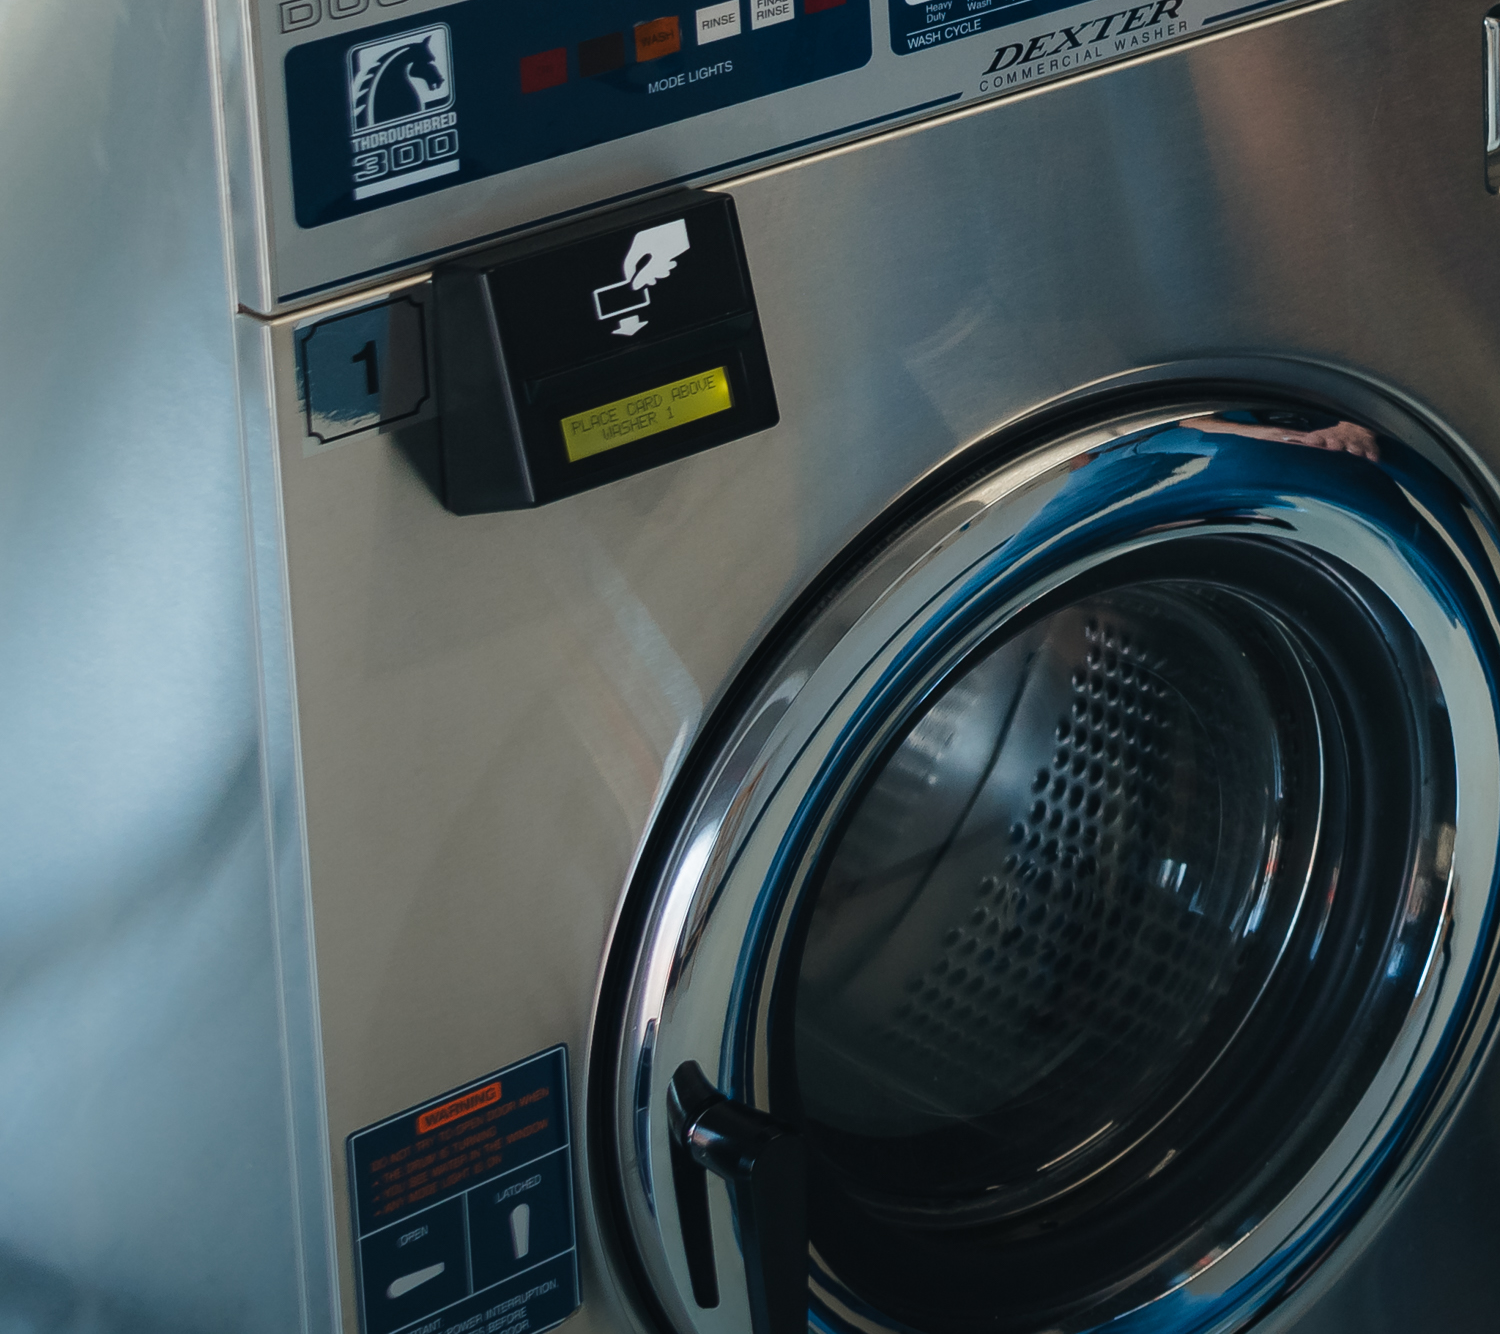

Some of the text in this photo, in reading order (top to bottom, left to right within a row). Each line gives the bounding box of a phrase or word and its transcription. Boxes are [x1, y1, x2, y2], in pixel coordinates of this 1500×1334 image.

[701, 12, 736, 31] RINSE
[756, 4, 790, 21] RINSE
[926, 0, 952, 14] Heavy
[926, 12, 946, 23] Duty
[641, 29, 674, 47] WASH
[907, 19, 982, 49] WASH CYCLE
[979, 20, 1188, 93] COMMERCIAL WASHER
[648, 60, 733, 94] MODE LIGHTS
[351, 111, 457, 152] THOROUGHBRED
[353, 128, 459, 183] 300
[351, 340, 379, 395] 1
[571, 373, 718, 436] PLACE CARD ABOVE
[602, 405, 674, 441] WASHER 1
[425, 1086, 497, 1126] WARNING
[495, 1173, 542, 1204] LATCHED
[397, 1225, 429, 1248] OPEN
[447, 1313, 483, 1334] POWER
[488, 1306, 527, 1332] BEFORE
